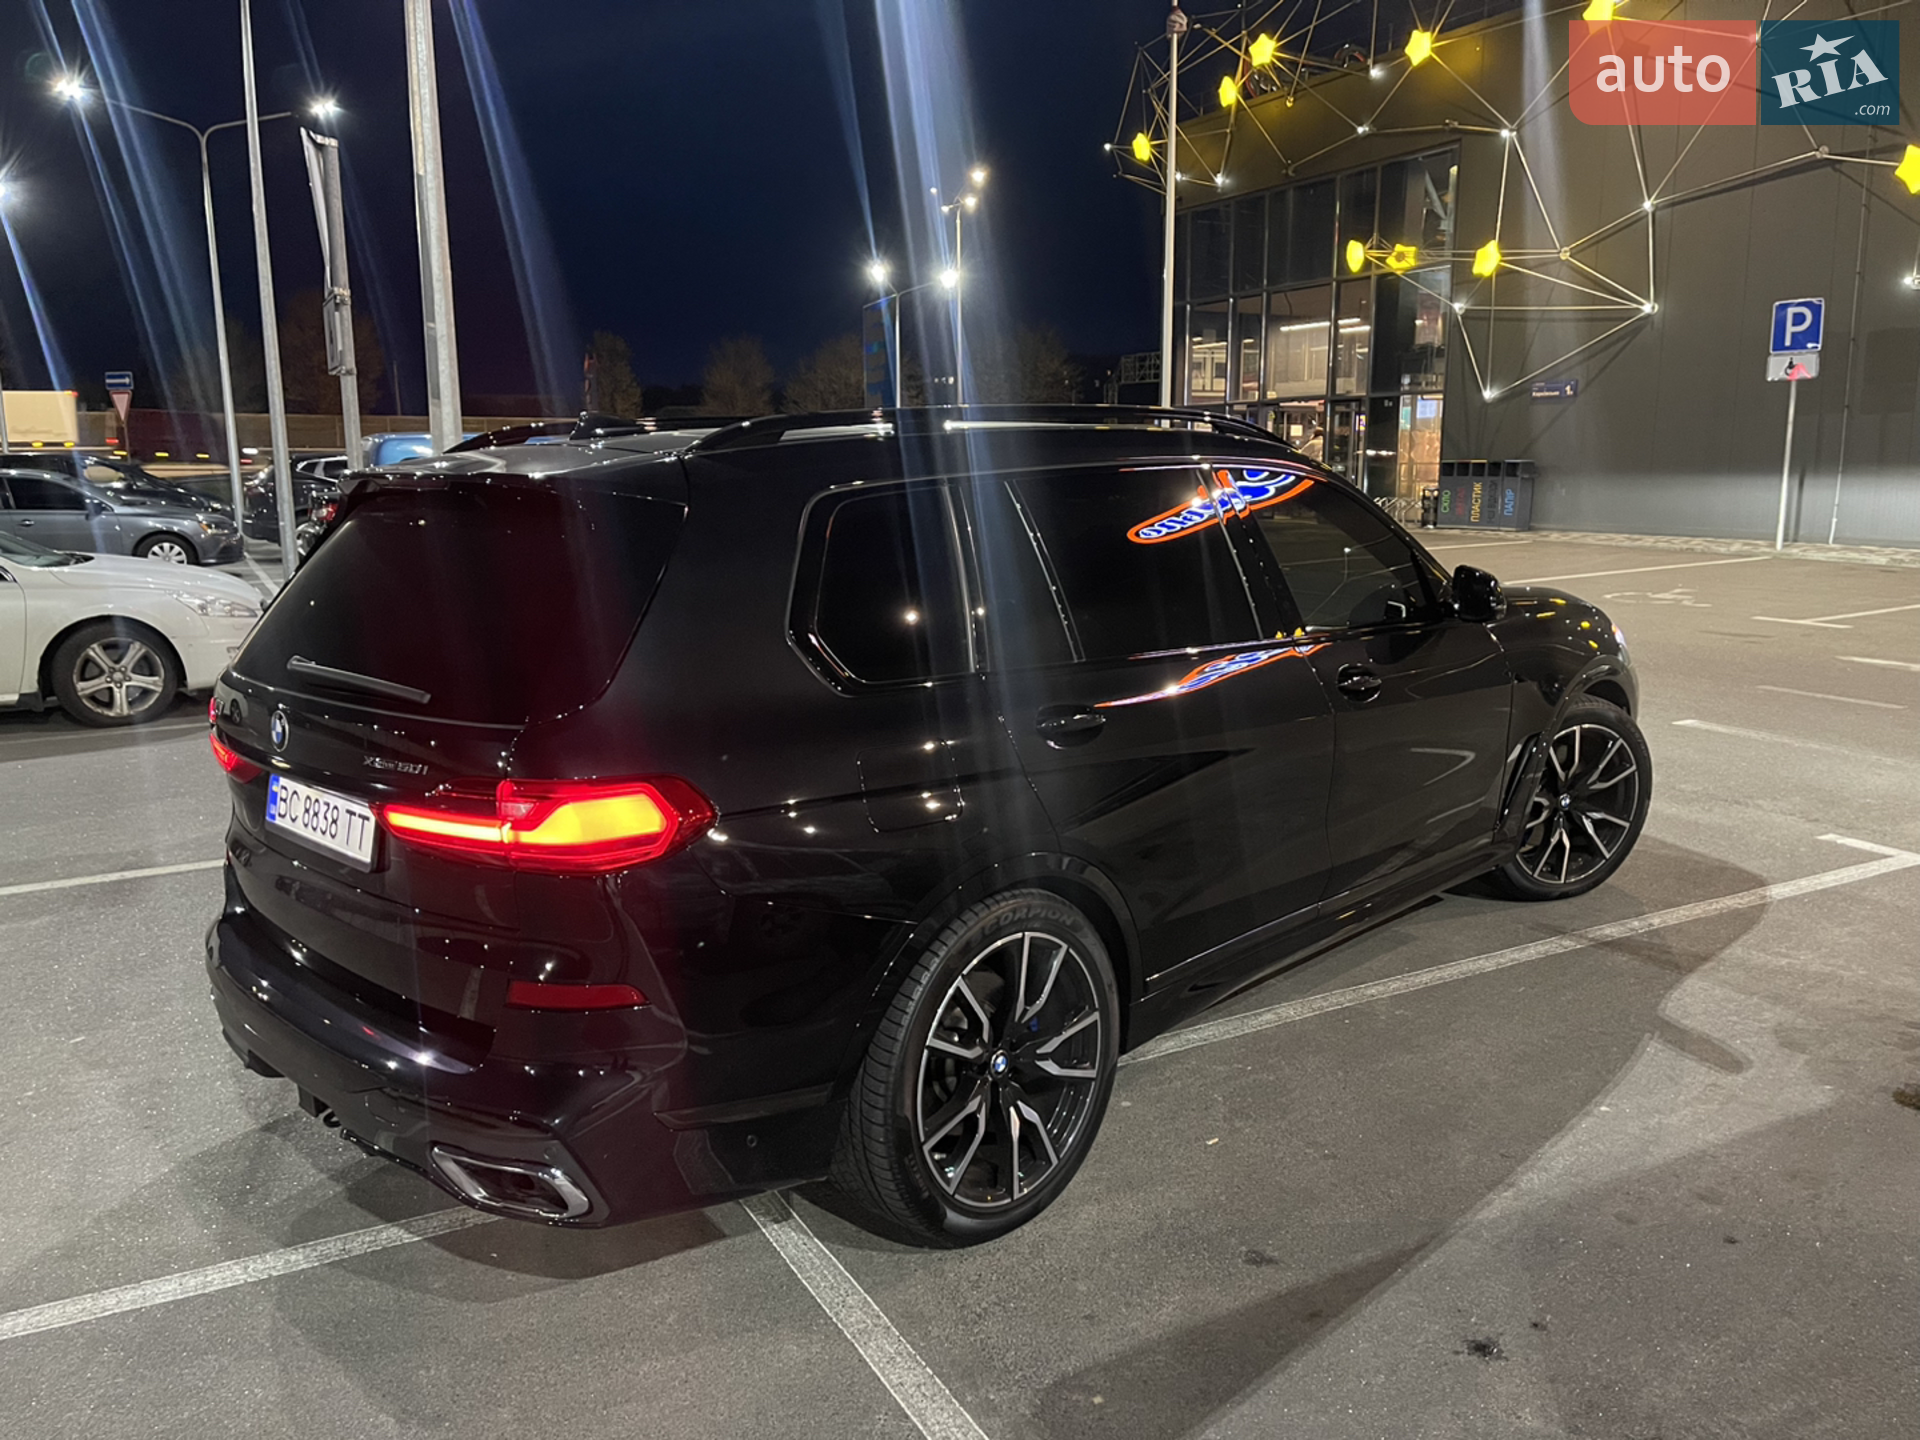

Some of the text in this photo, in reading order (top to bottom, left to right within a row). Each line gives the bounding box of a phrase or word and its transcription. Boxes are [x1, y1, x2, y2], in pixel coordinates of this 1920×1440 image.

[1784, 306, 1813, 347] P
[1470, 482, 1482, 522] ПЛАСТИК
[277, 785, 370, 852] BC 8838 TT
